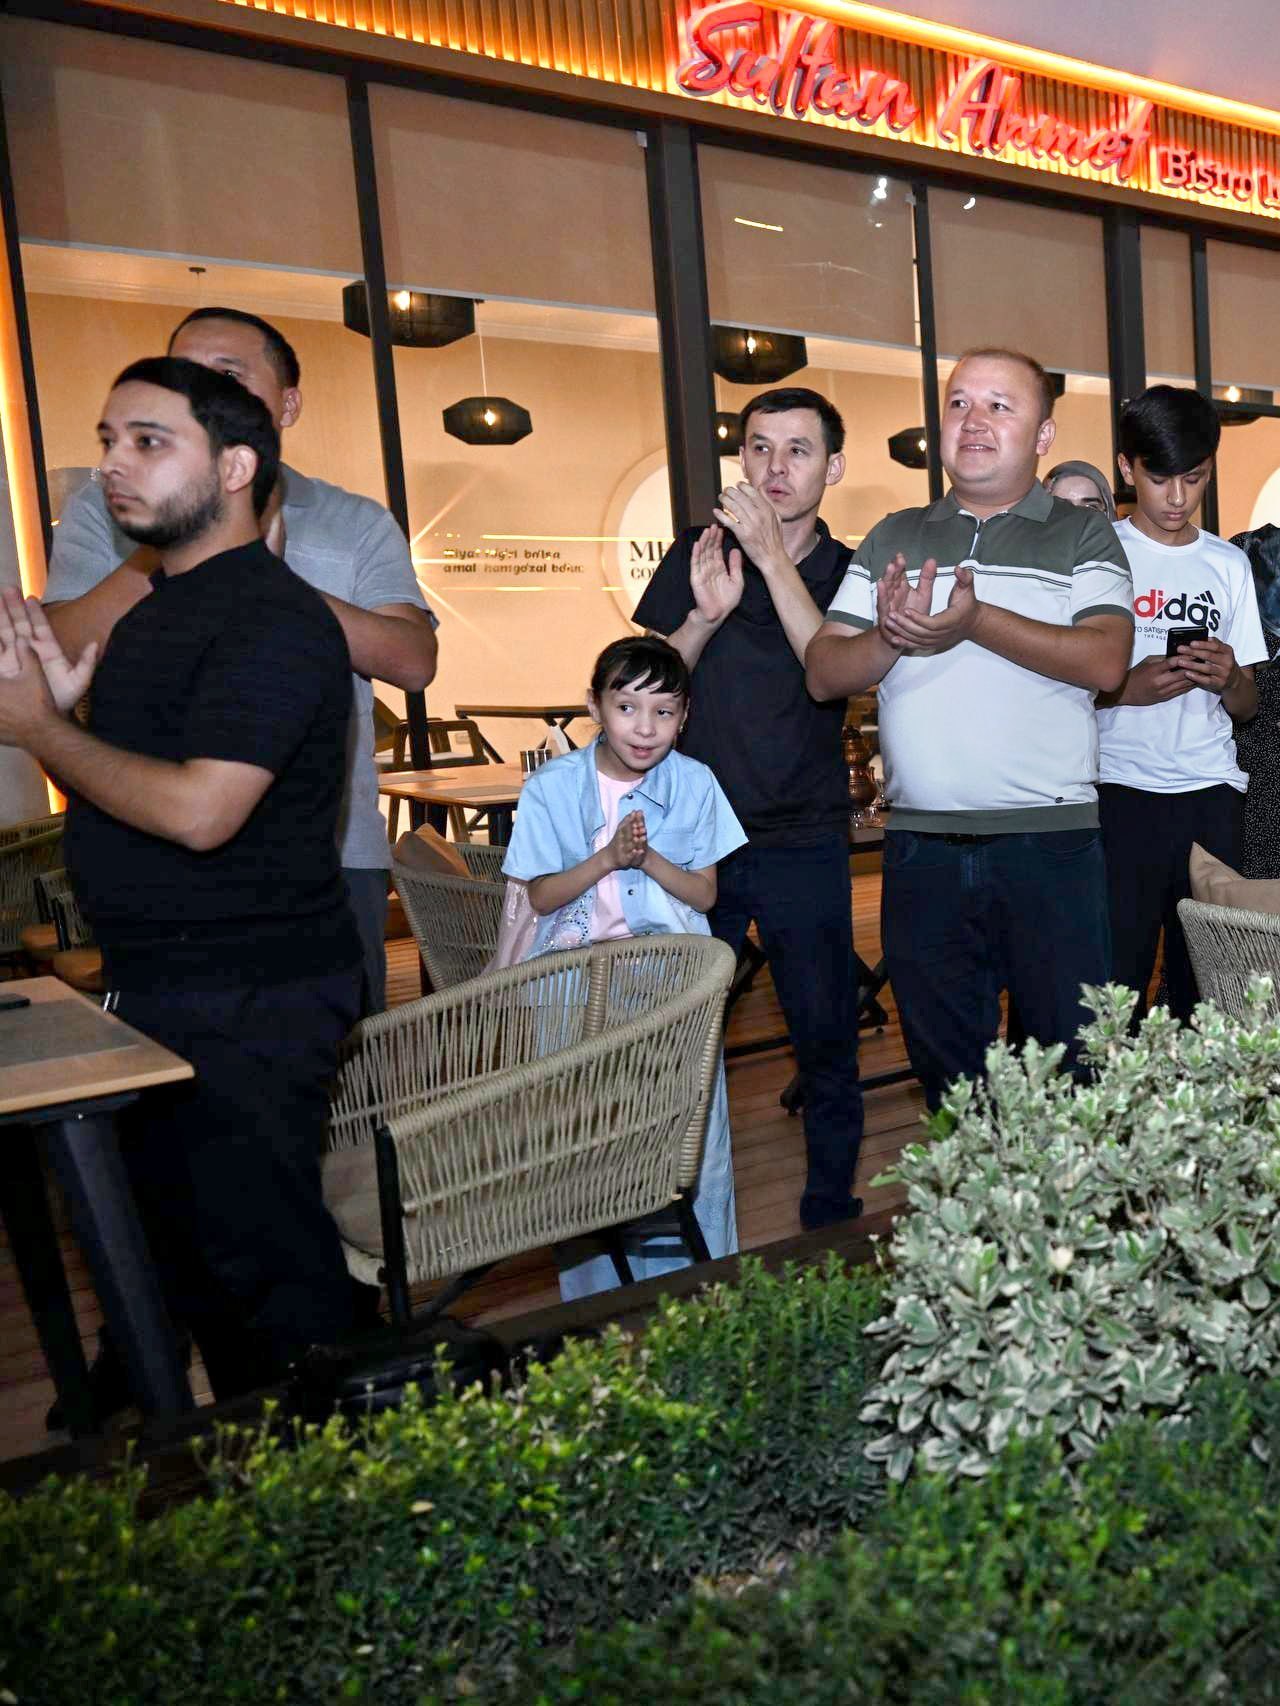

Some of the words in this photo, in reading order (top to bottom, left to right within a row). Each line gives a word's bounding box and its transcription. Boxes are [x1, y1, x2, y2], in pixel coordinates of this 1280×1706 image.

[676, 1, 920, 133] Sultan
[937, 60, 1153, 183] Ahmet
[1158, 148, 1255, 202] Bistro
[1133, 588, 1221, 632] didas
